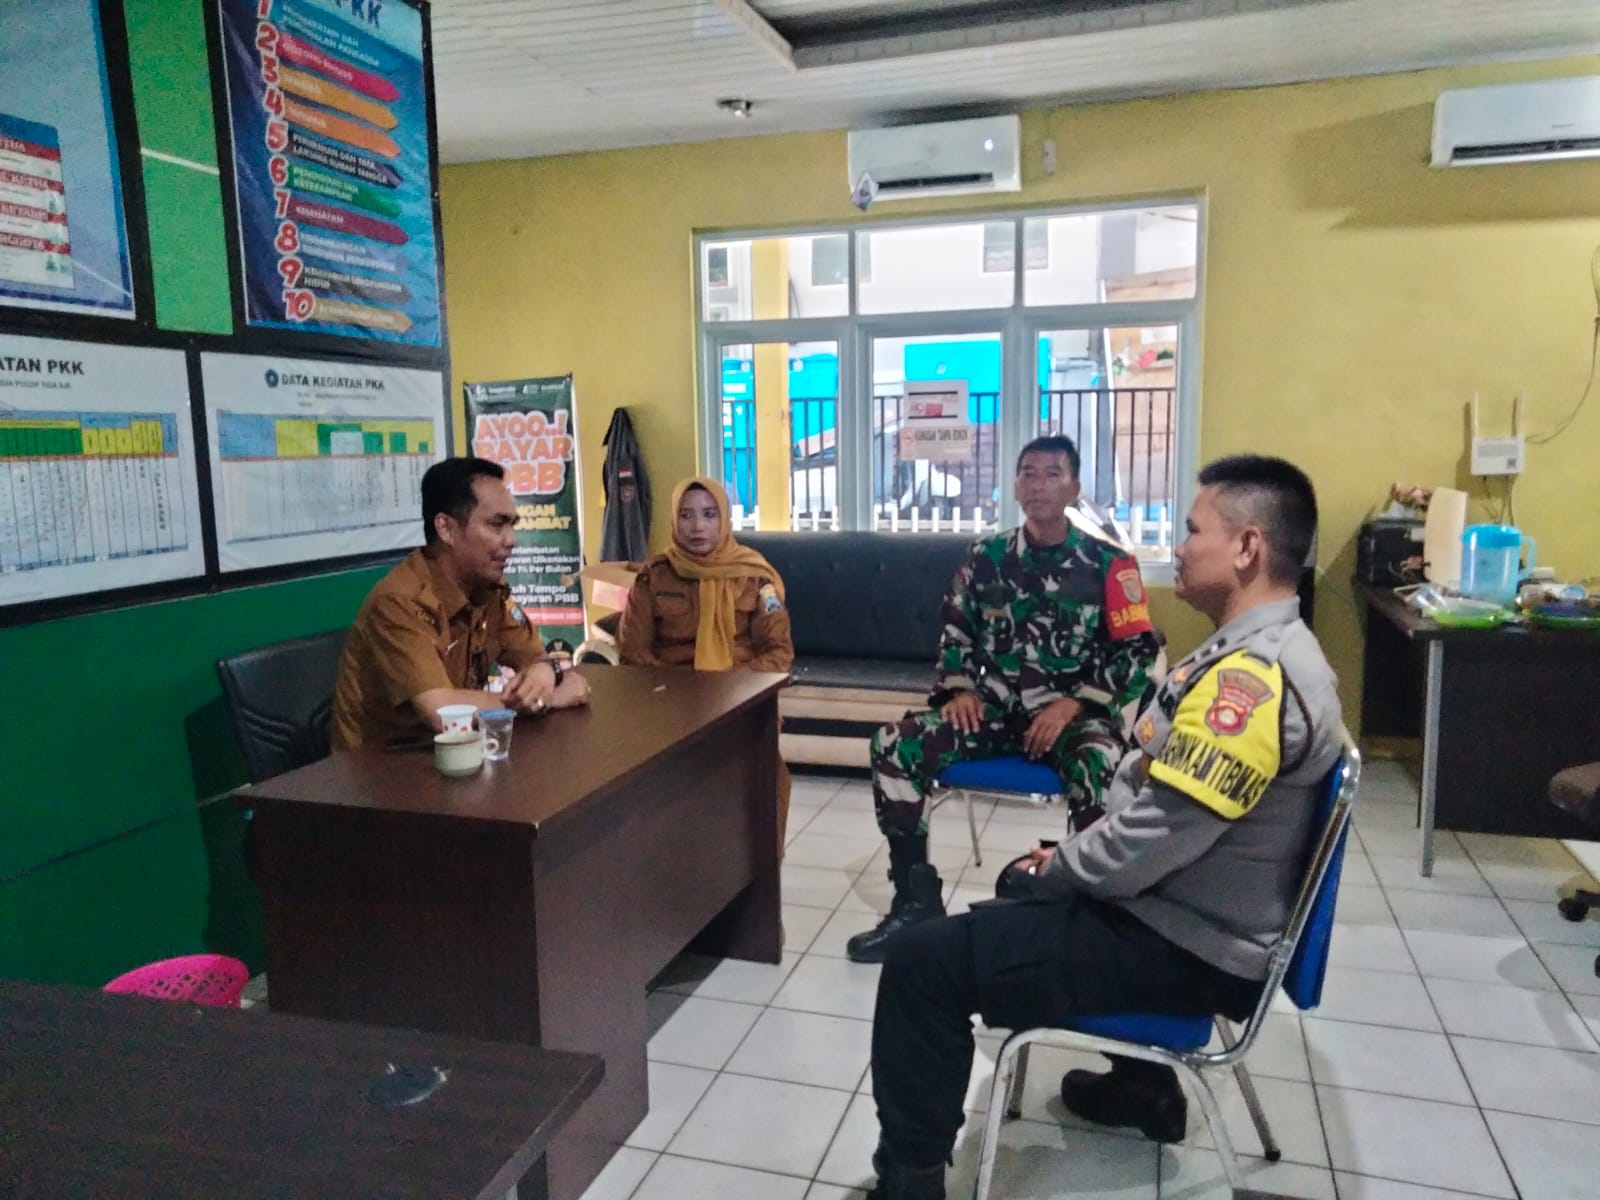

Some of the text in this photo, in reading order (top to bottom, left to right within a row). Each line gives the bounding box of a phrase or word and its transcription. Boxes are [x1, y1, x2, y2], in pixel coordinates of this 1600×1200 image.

[256, 22, 278, 50] 2
[261, 53, 279, 83] 3
[263, 87, 284, 117] 4
[266, 119, 288, 151] 5
[268, 154, 288, 187] 6
[274, 189, 291, 219] 7
[274, 220, 298, 255] 8
[278, 256, 303, 289] 9
[283, 289, 315, 321] 10
[47, 359, 84, 375] PKK
[281, 374, 386, 391] DATA KEGIATAN PKK
[473, 436, 573, 462] BAYAR
[504, 461, 565, 494] BB
[530, 565, 544, 573] Per
[545, 565, 572, 573] Bulan
[528, 585, 566, 594] Tempo
[554, 593, 579, 603] PBB
